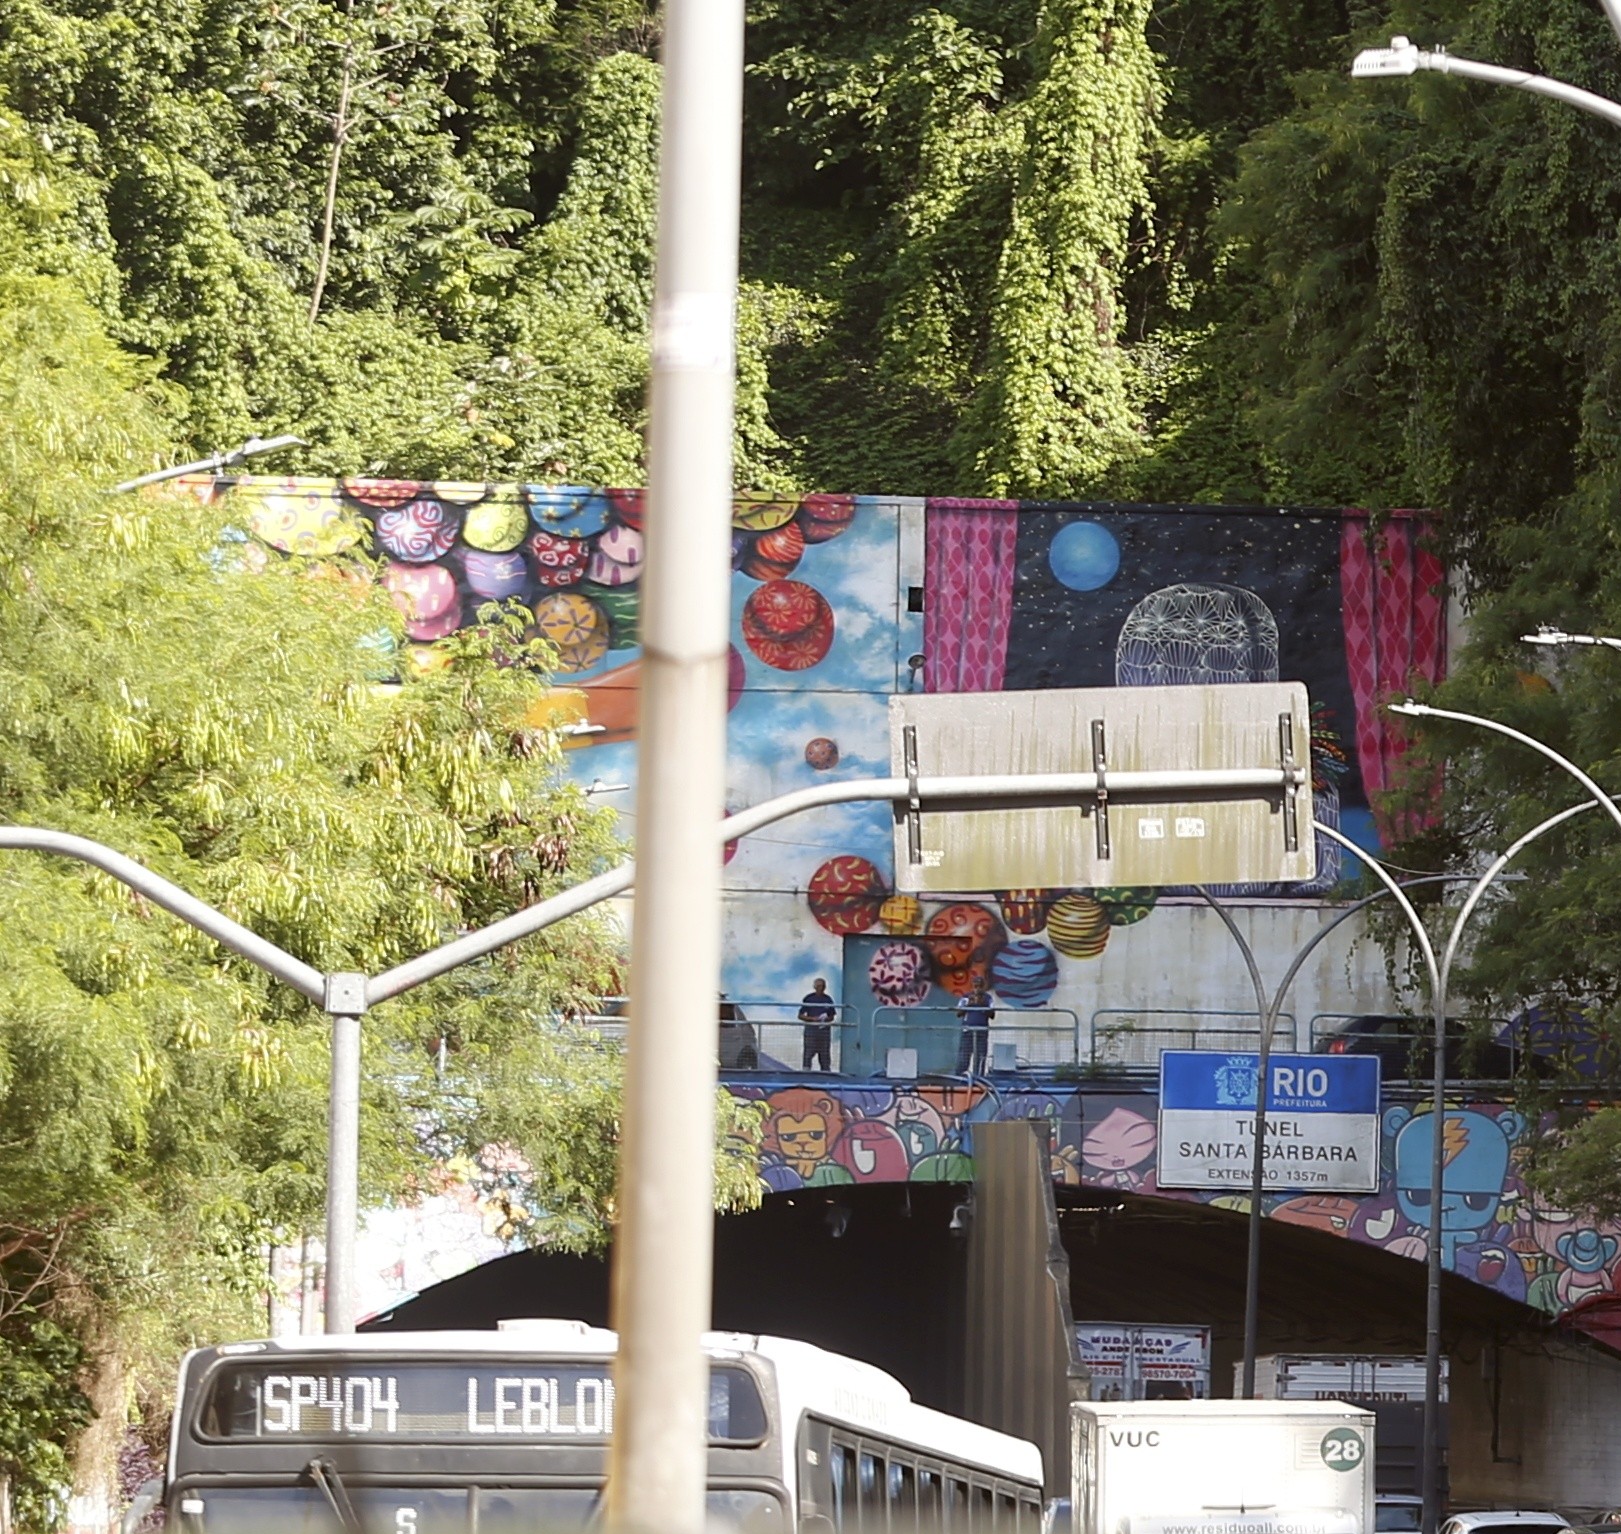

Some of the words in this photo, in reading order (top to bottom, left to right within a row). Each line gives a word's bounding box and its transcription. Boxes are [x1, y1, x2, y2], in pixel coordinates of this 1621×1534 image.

[1272, 1067, 1328, 1098] RIO
[1273, 1098, 1328, 1108] PREFEITURA
[1179, 1142, 1248, 1159] SANTA
[1261, 1140, 1358, 1162] BÁRBARA
[1208, 1168, 1278, 1181] EXTENO
[1286, 1171, 1328, 1182] 1357m
[263, 1376, 400, 1434] SP404
[1110, 1430, 1161, 1448] VUC
[1325, 1439, 1361, 1462] 28
